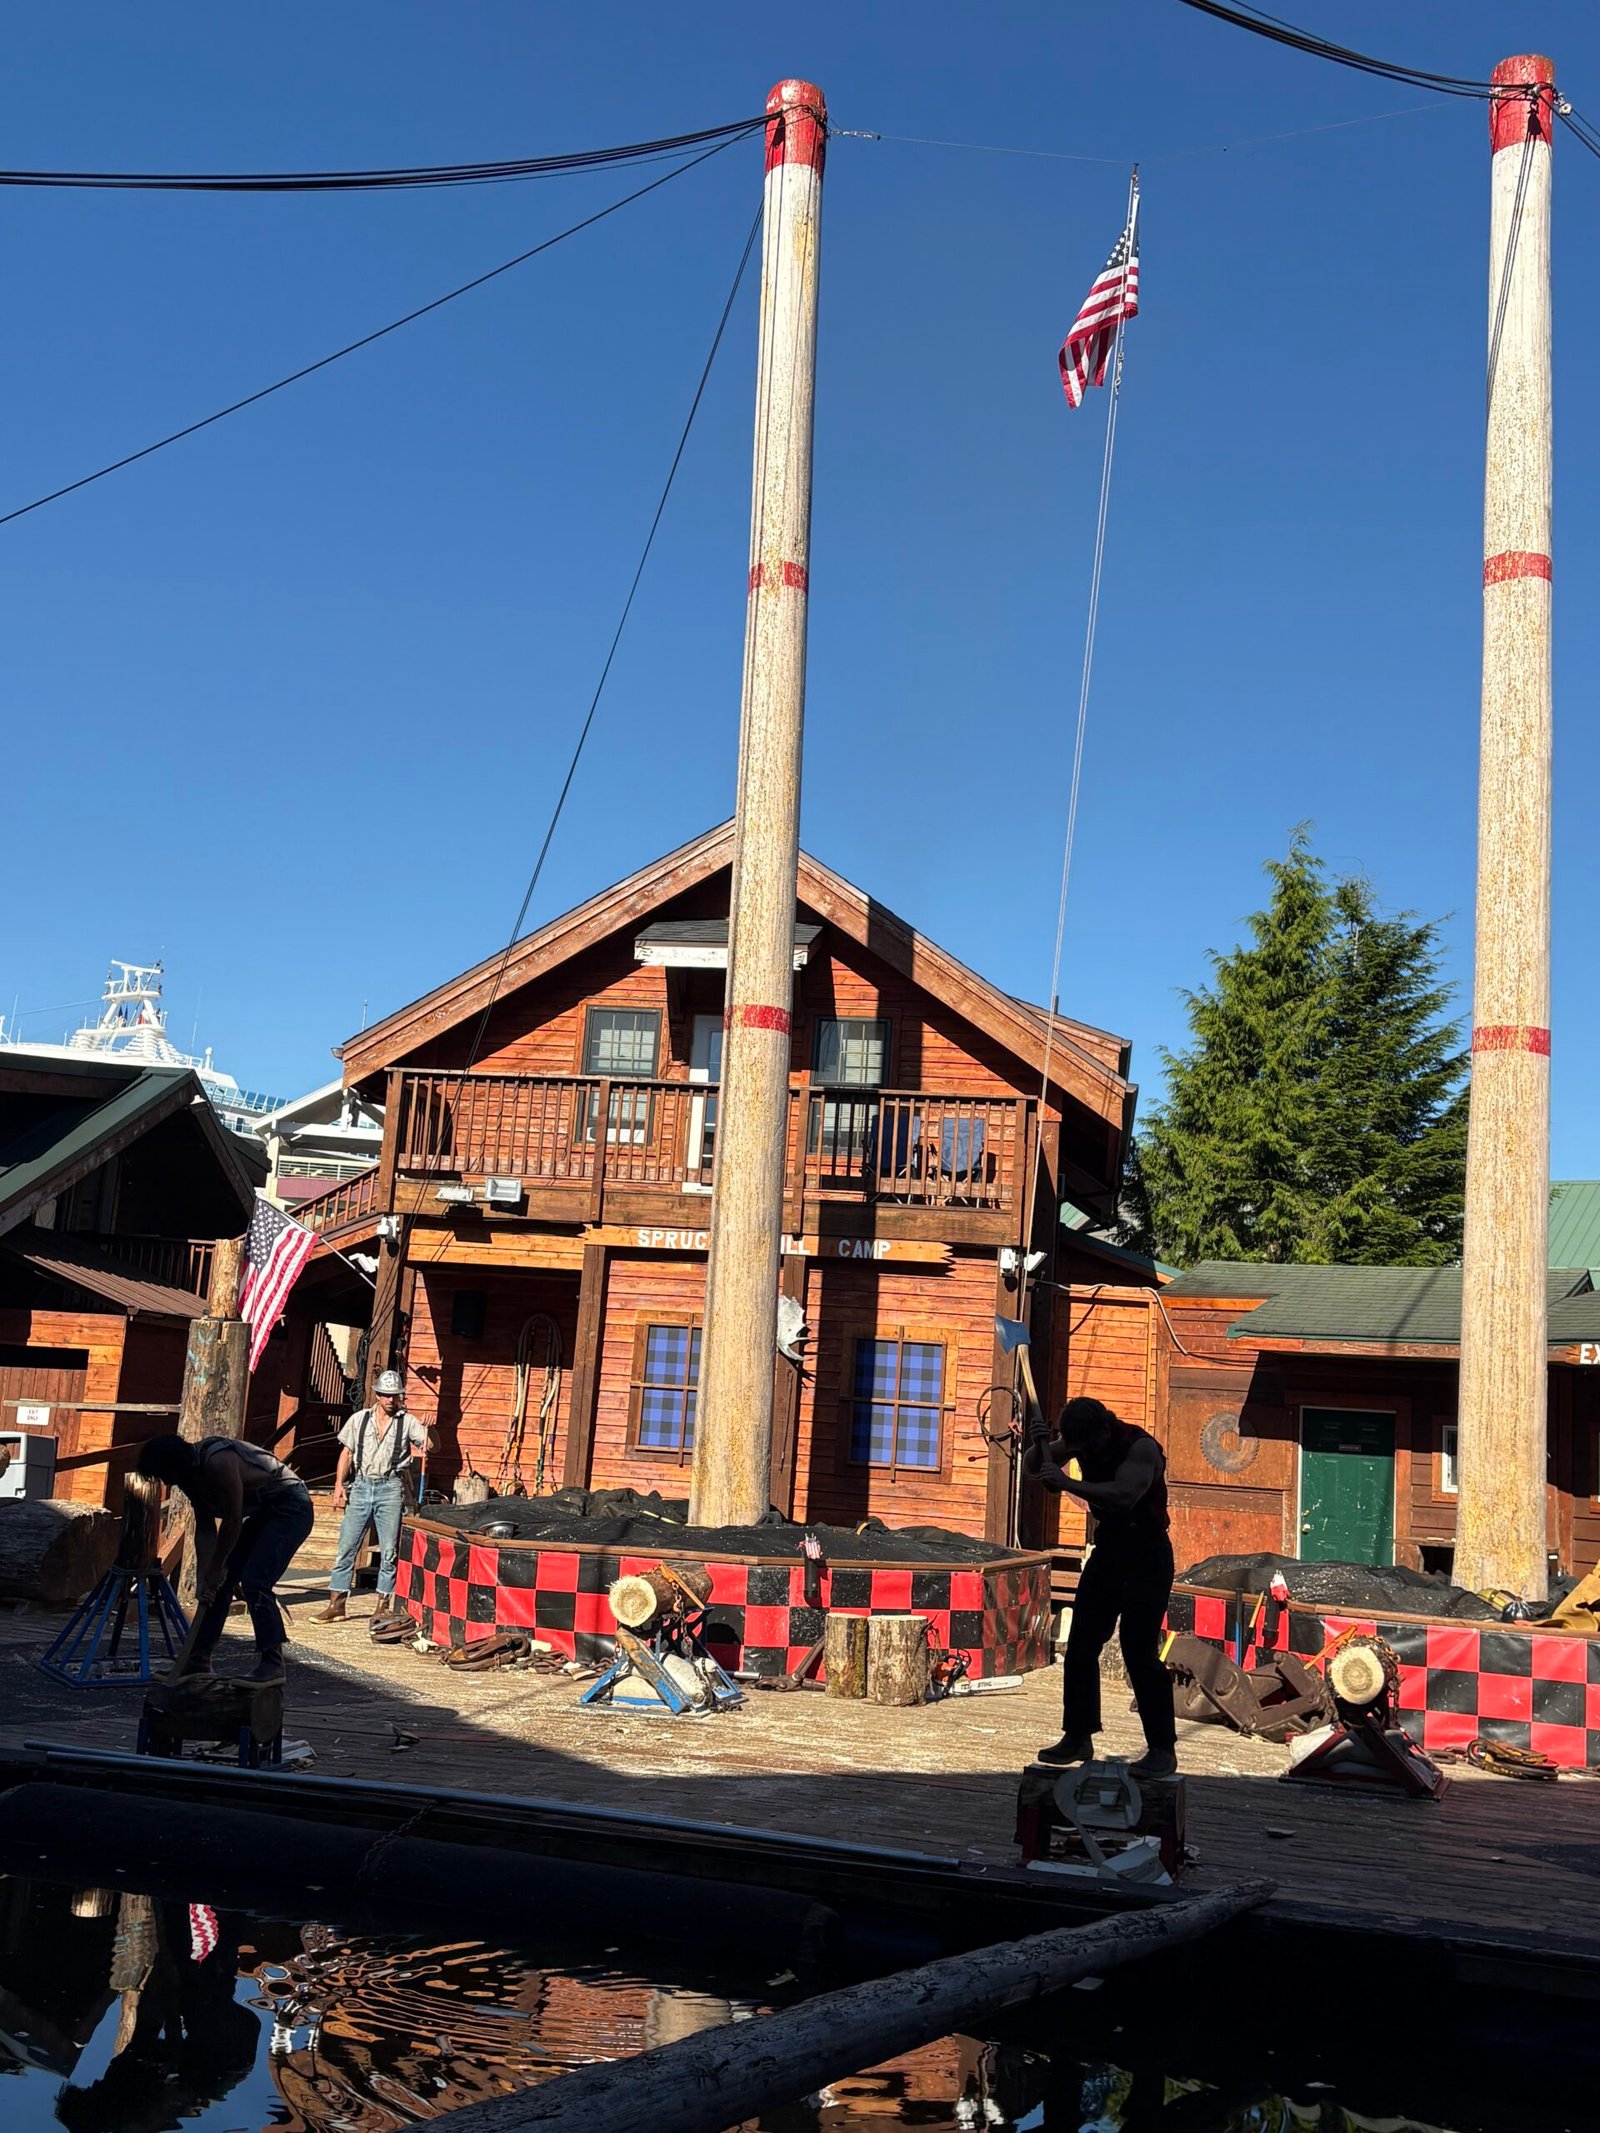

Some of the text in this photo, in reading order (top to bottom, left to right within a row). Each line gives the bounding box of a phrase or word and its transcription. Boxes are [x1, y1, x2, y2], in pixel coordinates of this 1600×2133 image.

[638, 1229, 891, 1260] SPRUC ILL CAMP
